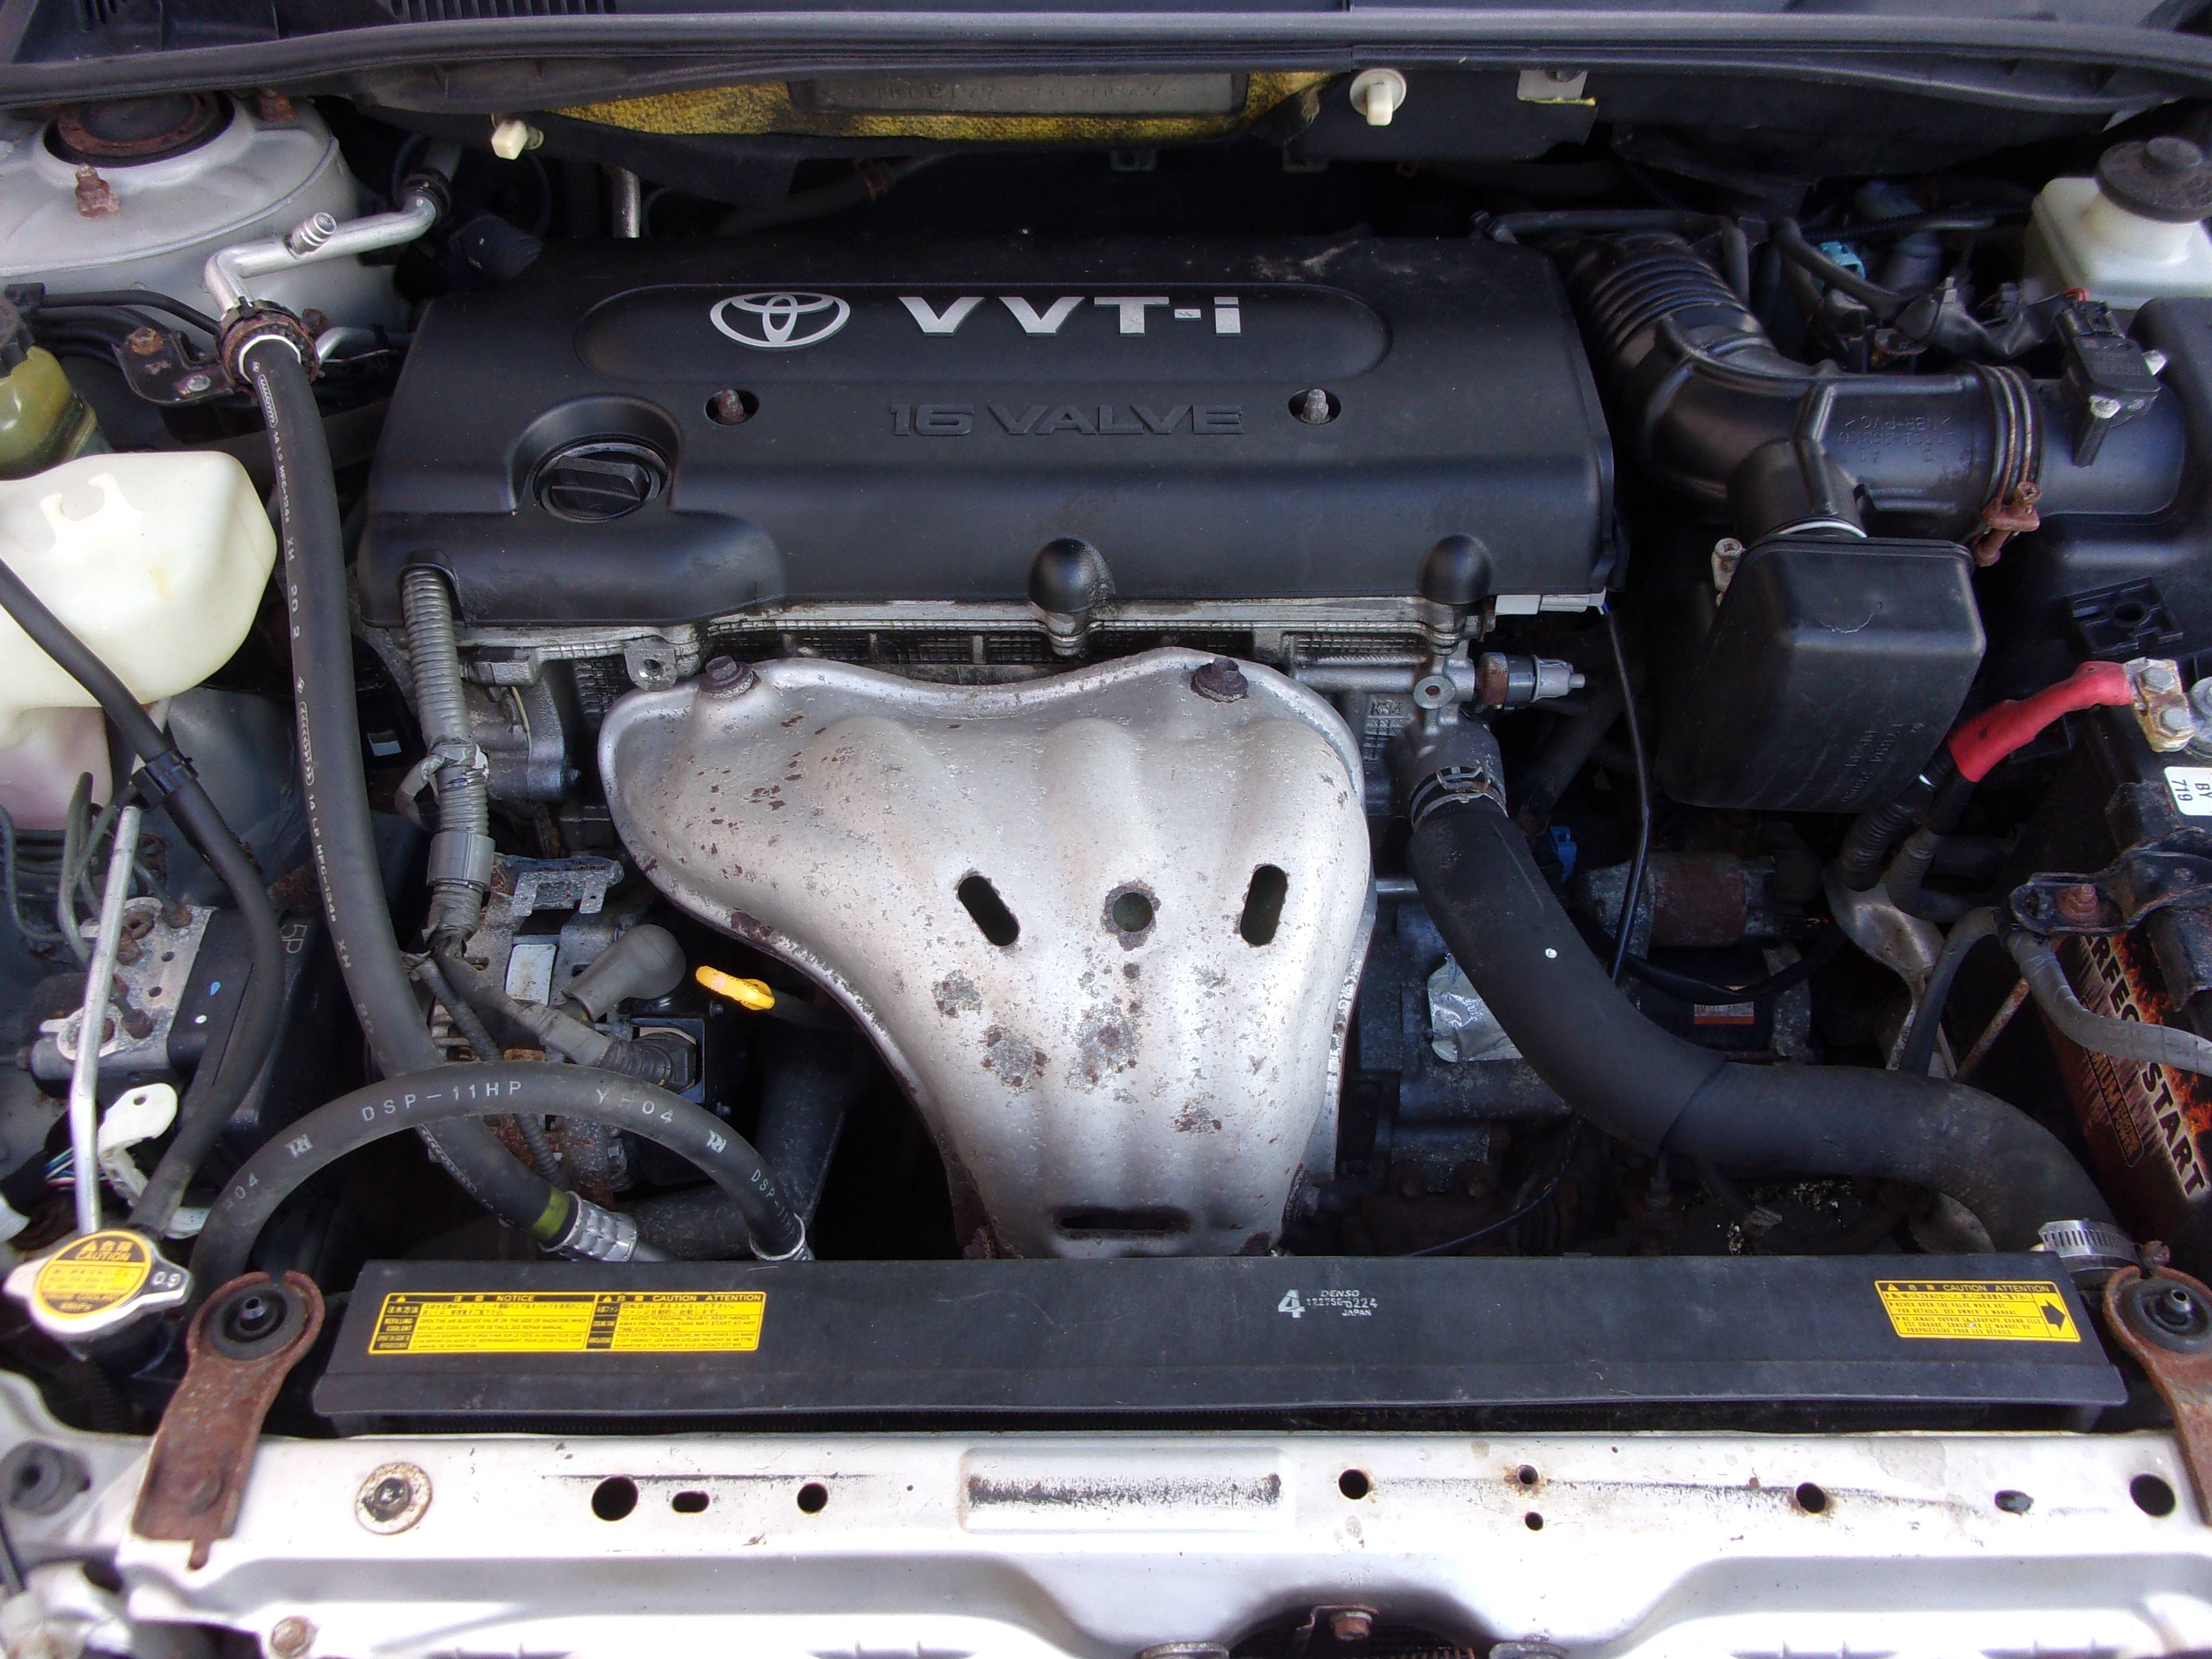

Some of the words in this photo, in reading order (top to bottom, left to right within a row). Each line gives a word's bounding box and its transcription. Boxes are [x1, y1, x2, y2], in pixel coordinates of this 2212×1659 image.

[899, 296, 1242, 337] VVT-i
[890, 404, 974, 436] 16
[989, 404, 1244, 435] VALVE
[2171, 779, 2193, 801] 719
[362, 1080, 521, 1121] DSP-11HP
[2140, 1062, 2208, 1200] START
[1278, 1289, 1306, 1318] 4
